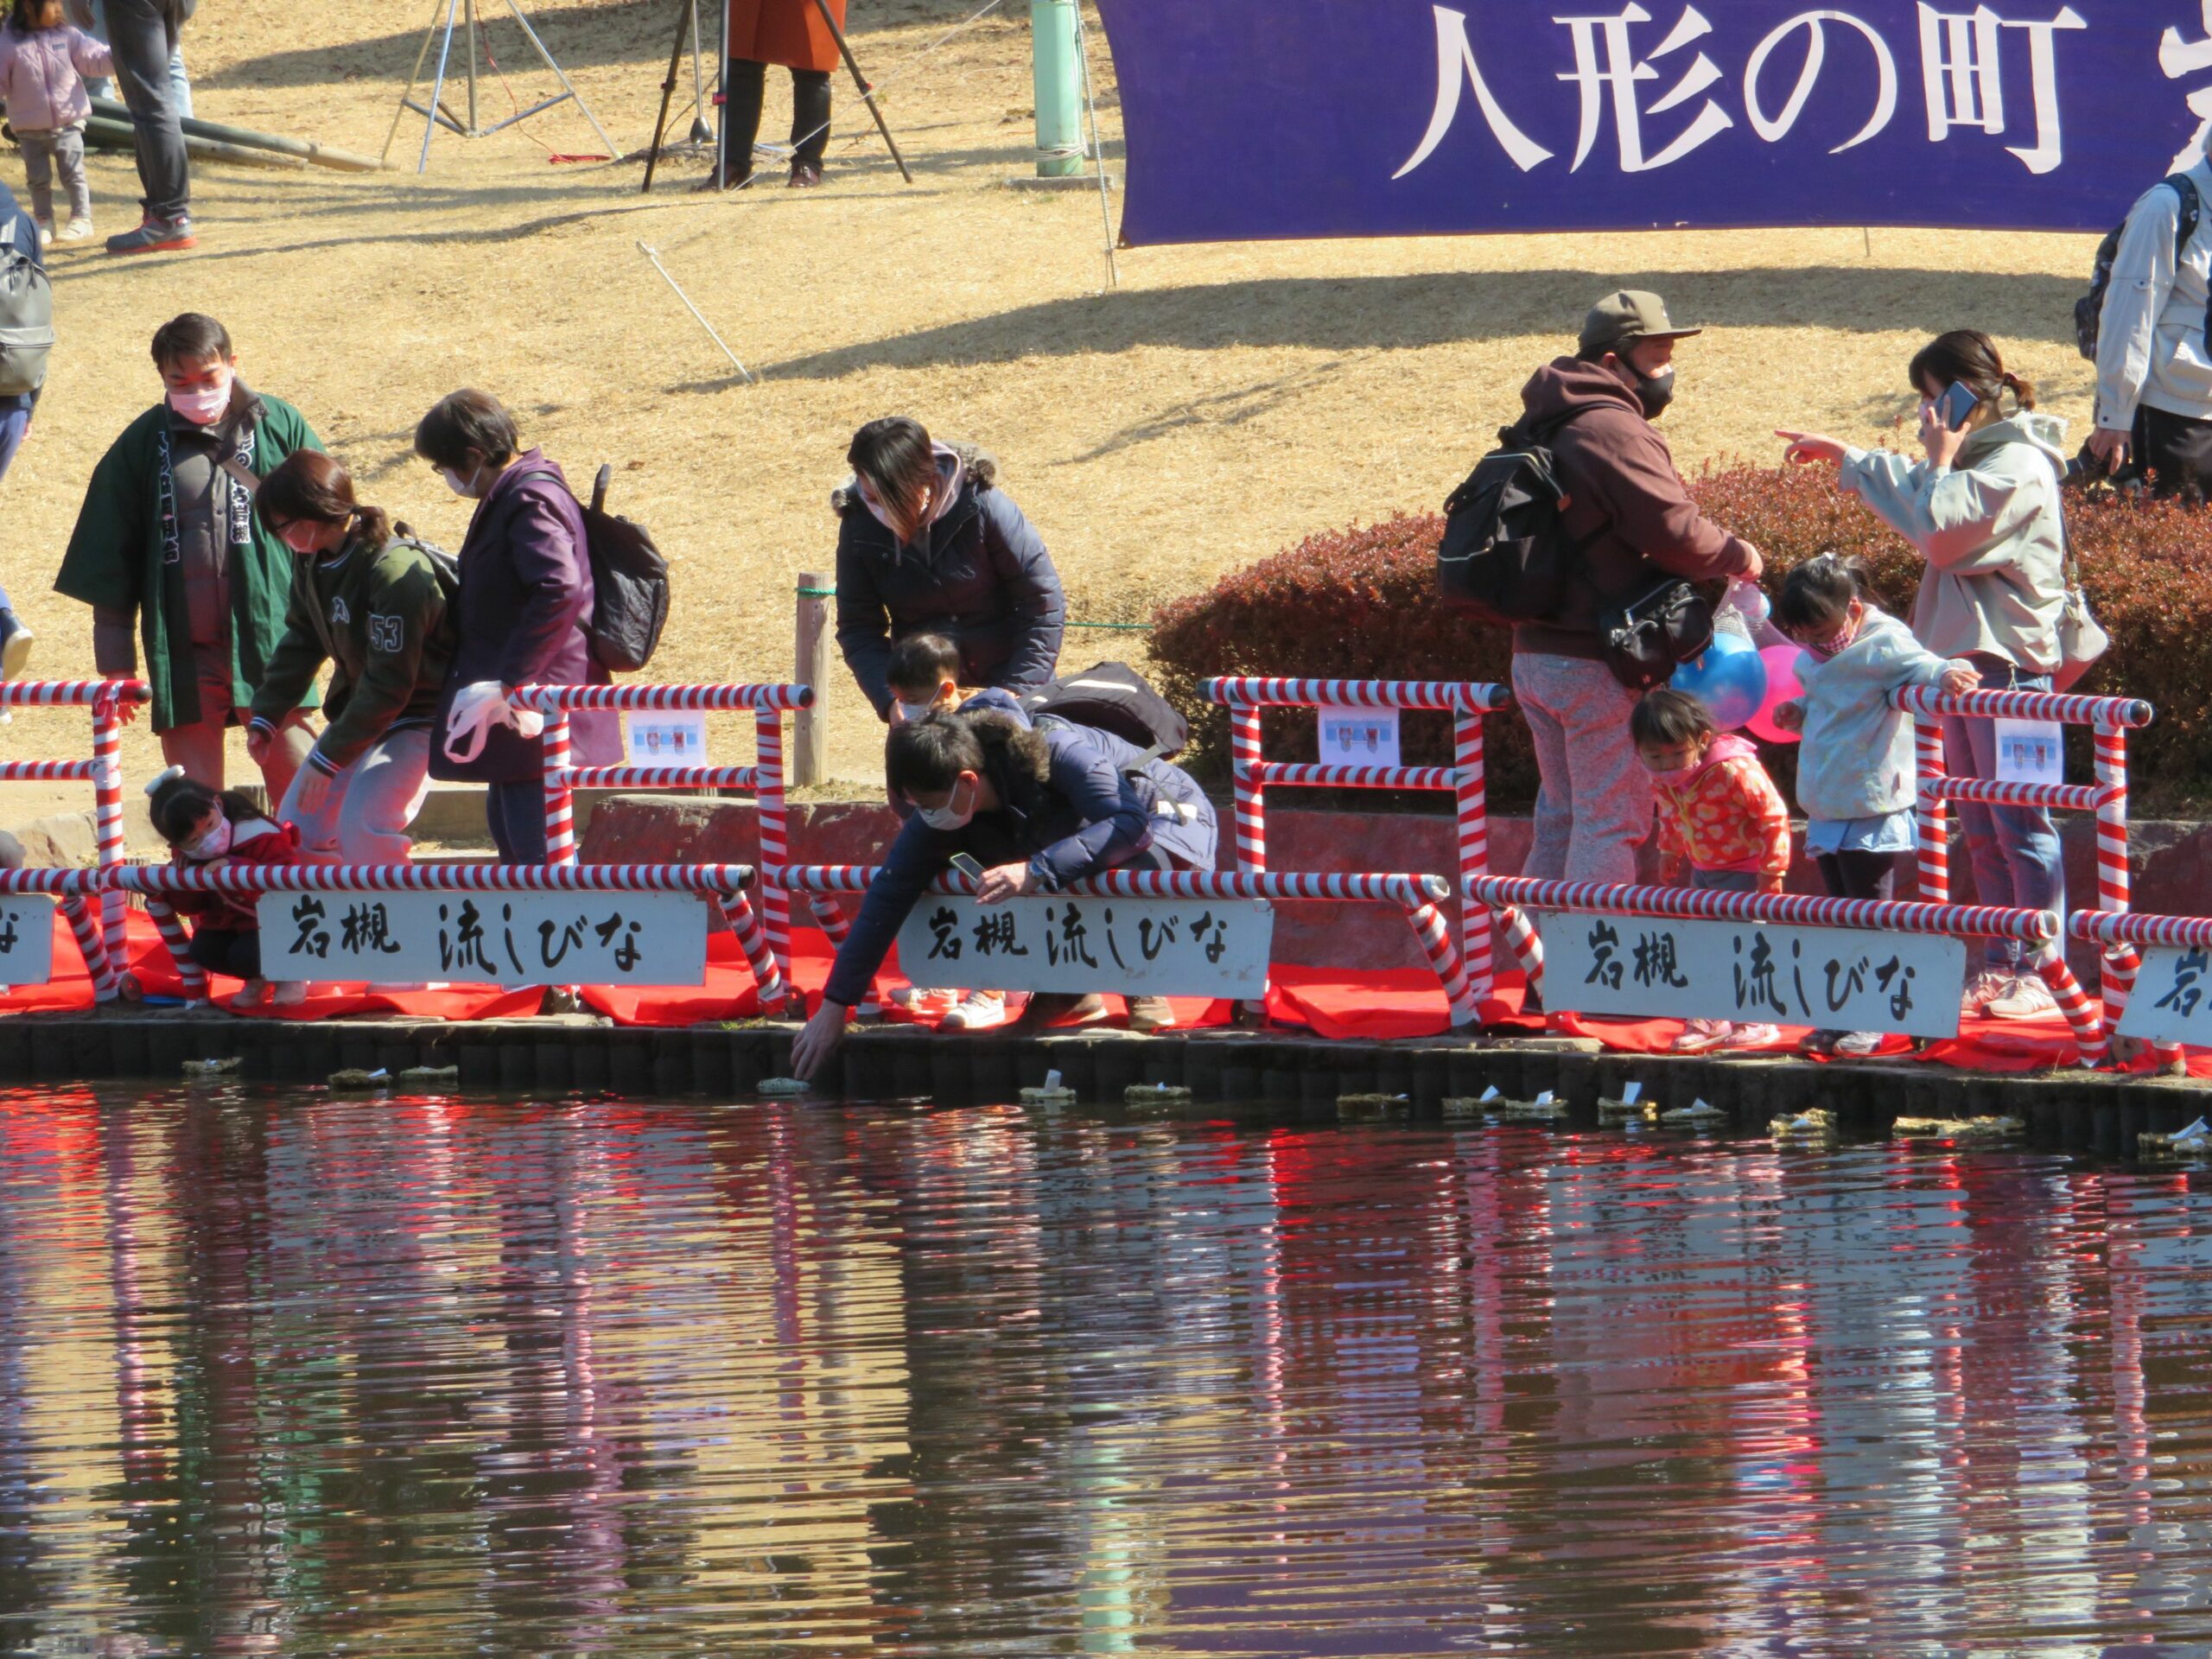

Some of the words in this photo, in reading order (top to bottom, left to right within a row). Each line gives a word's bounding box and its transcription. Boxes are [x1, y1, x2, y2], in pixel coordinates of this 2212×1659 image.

[1391, 1, 2088, 180] 人形の町
[371, 613, 404, 652] 53
[288, 893, 401, 959] 岩槻
[438, 899, 642, 976] 流しびな
[927, 906, 1029, 961] 岩槻
[1046, 901, 1228, 969] 流しびな
[1584, 918, 1689, 990] 岩槻
[1732, 931, 1916, 1021] 流しびな
